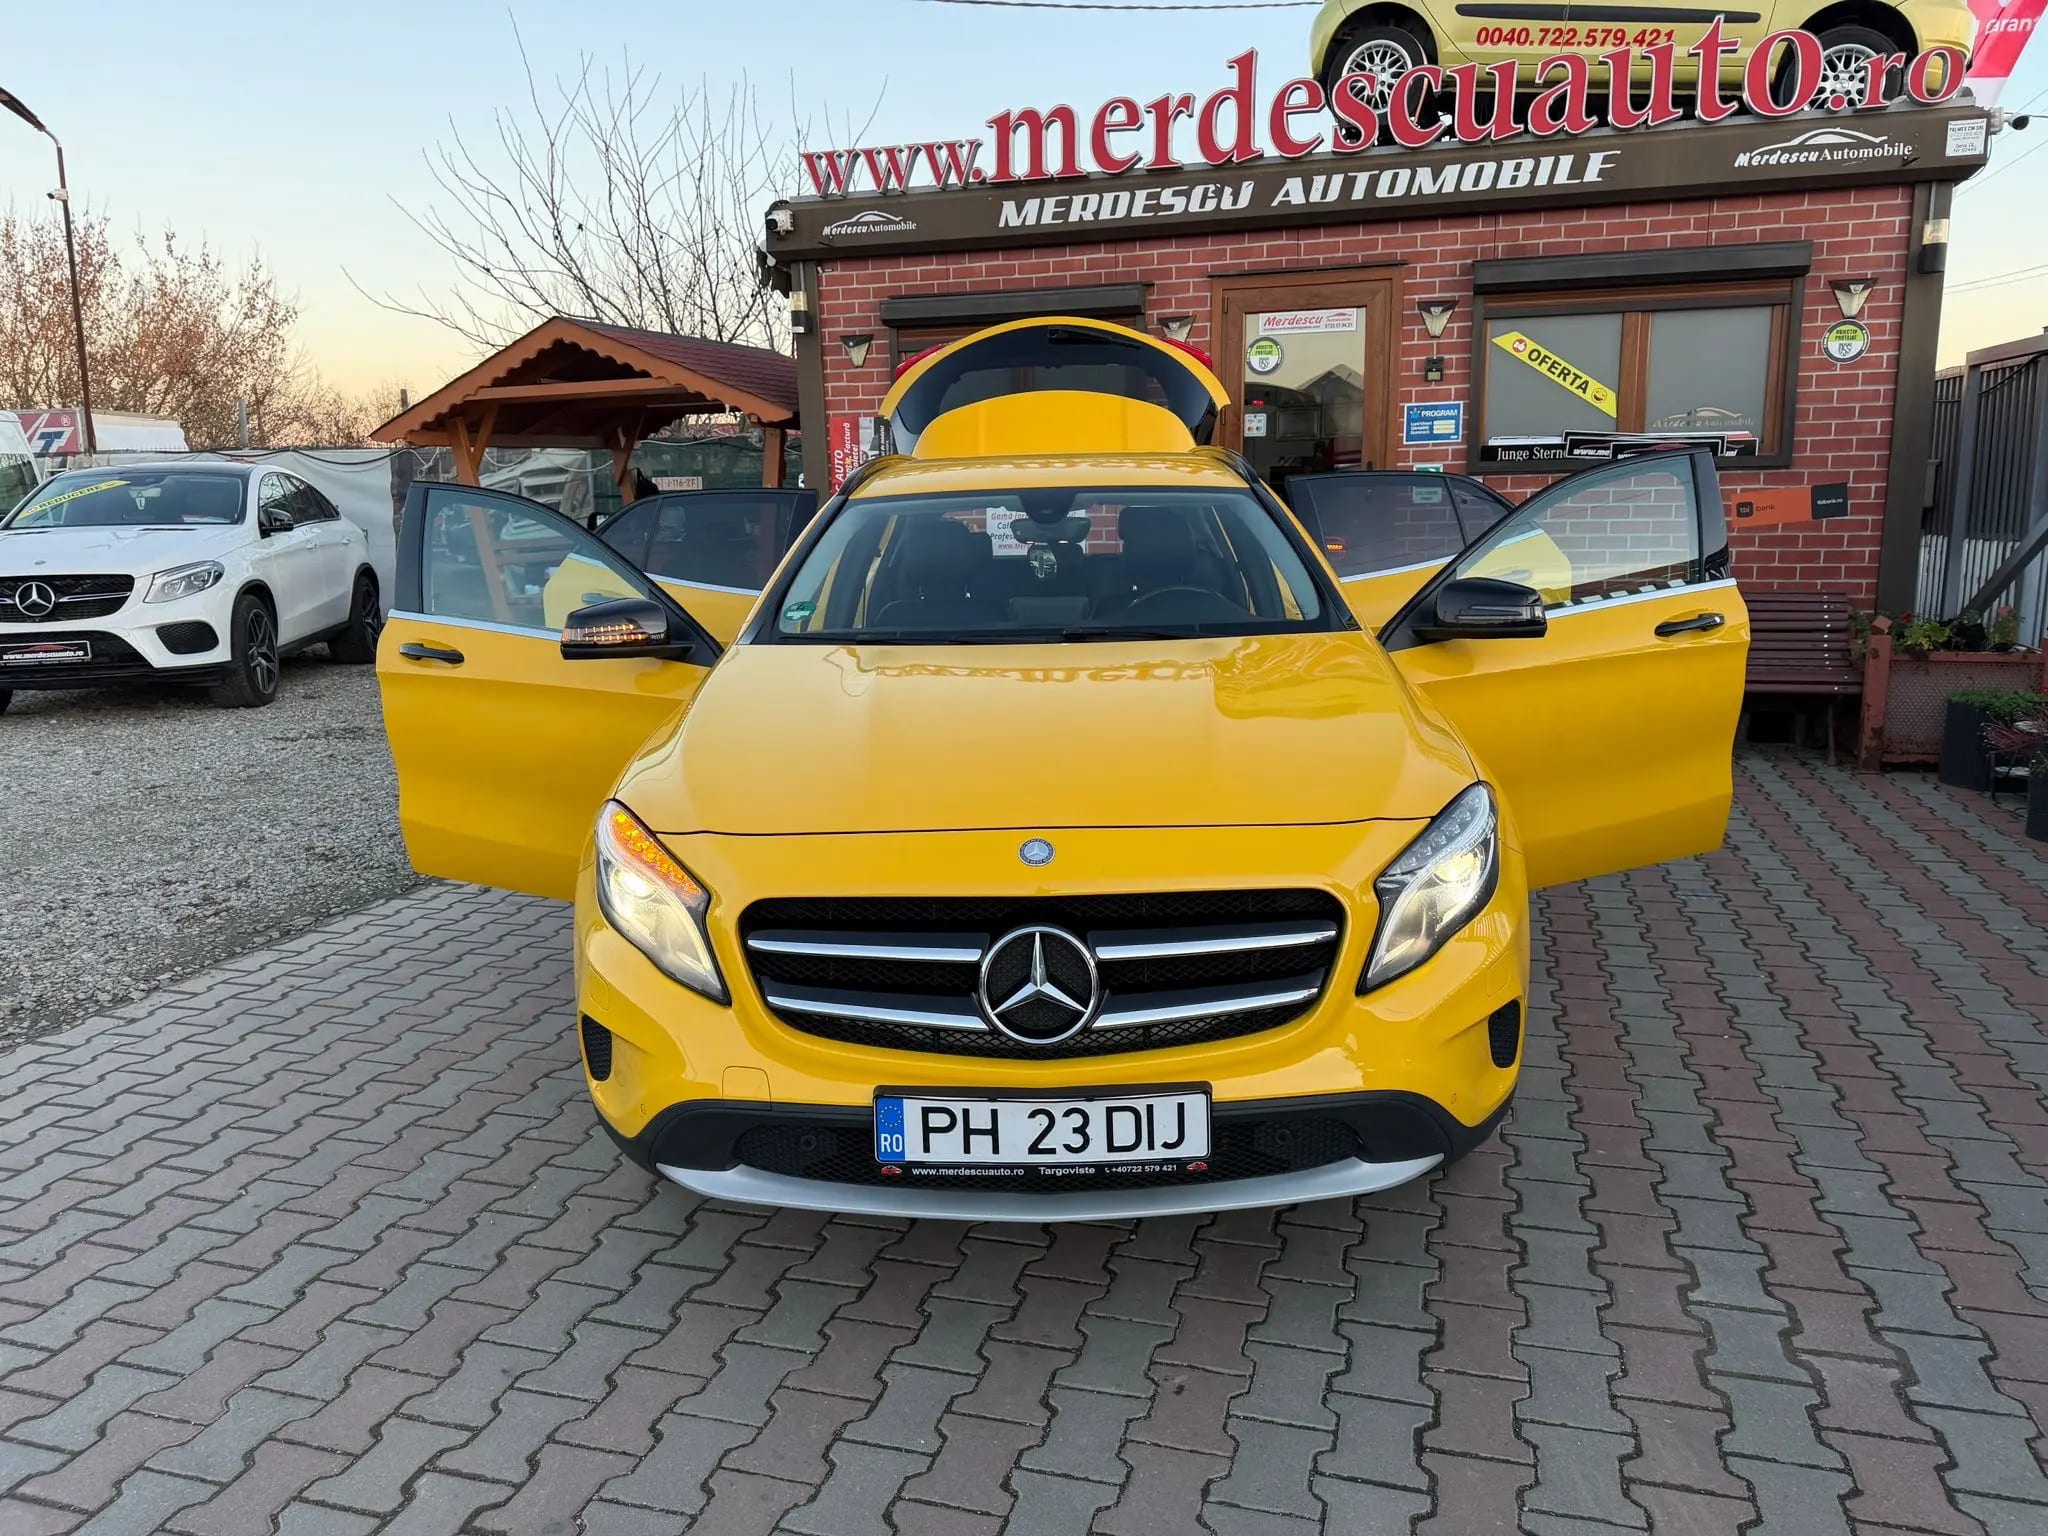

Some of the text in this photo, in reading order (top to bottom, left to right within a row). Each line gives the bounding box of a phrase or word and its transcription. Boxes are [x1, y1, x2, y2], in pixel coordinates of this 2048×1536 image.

[1476, 27, 1675, 48] 0040.722.579.421
[802, 14, 1967, 198] www.merdescuauto.ro
[1735, 143, 1912, 168] Merdescu Automobile
[998, 150, 1622, 228] MERDESCU AUTOMOBILE
[822, 221, 917, 236] Merdescu Automobile
[1263, 314, 1323, 327] Merdescu
[1527, 347, 1590, 395] OFERTA
[1421, 409, 1458, 417] PROGRAM
[1497, 448, 1530, 461] Junge
[834, 449, 844, 482] AUTO
[39, 486, 102, 509] REDUCERE
[1756, 504, 1776, 512] bank
[921, 1102, 1186, 1155] PH 23 DIJ
[880, 1133, 902, 1153] RO
[911, 1167, 1025, 1176] www.merdescuauto.ro
[1038, 1166, 1096, 1176] Targoviste
